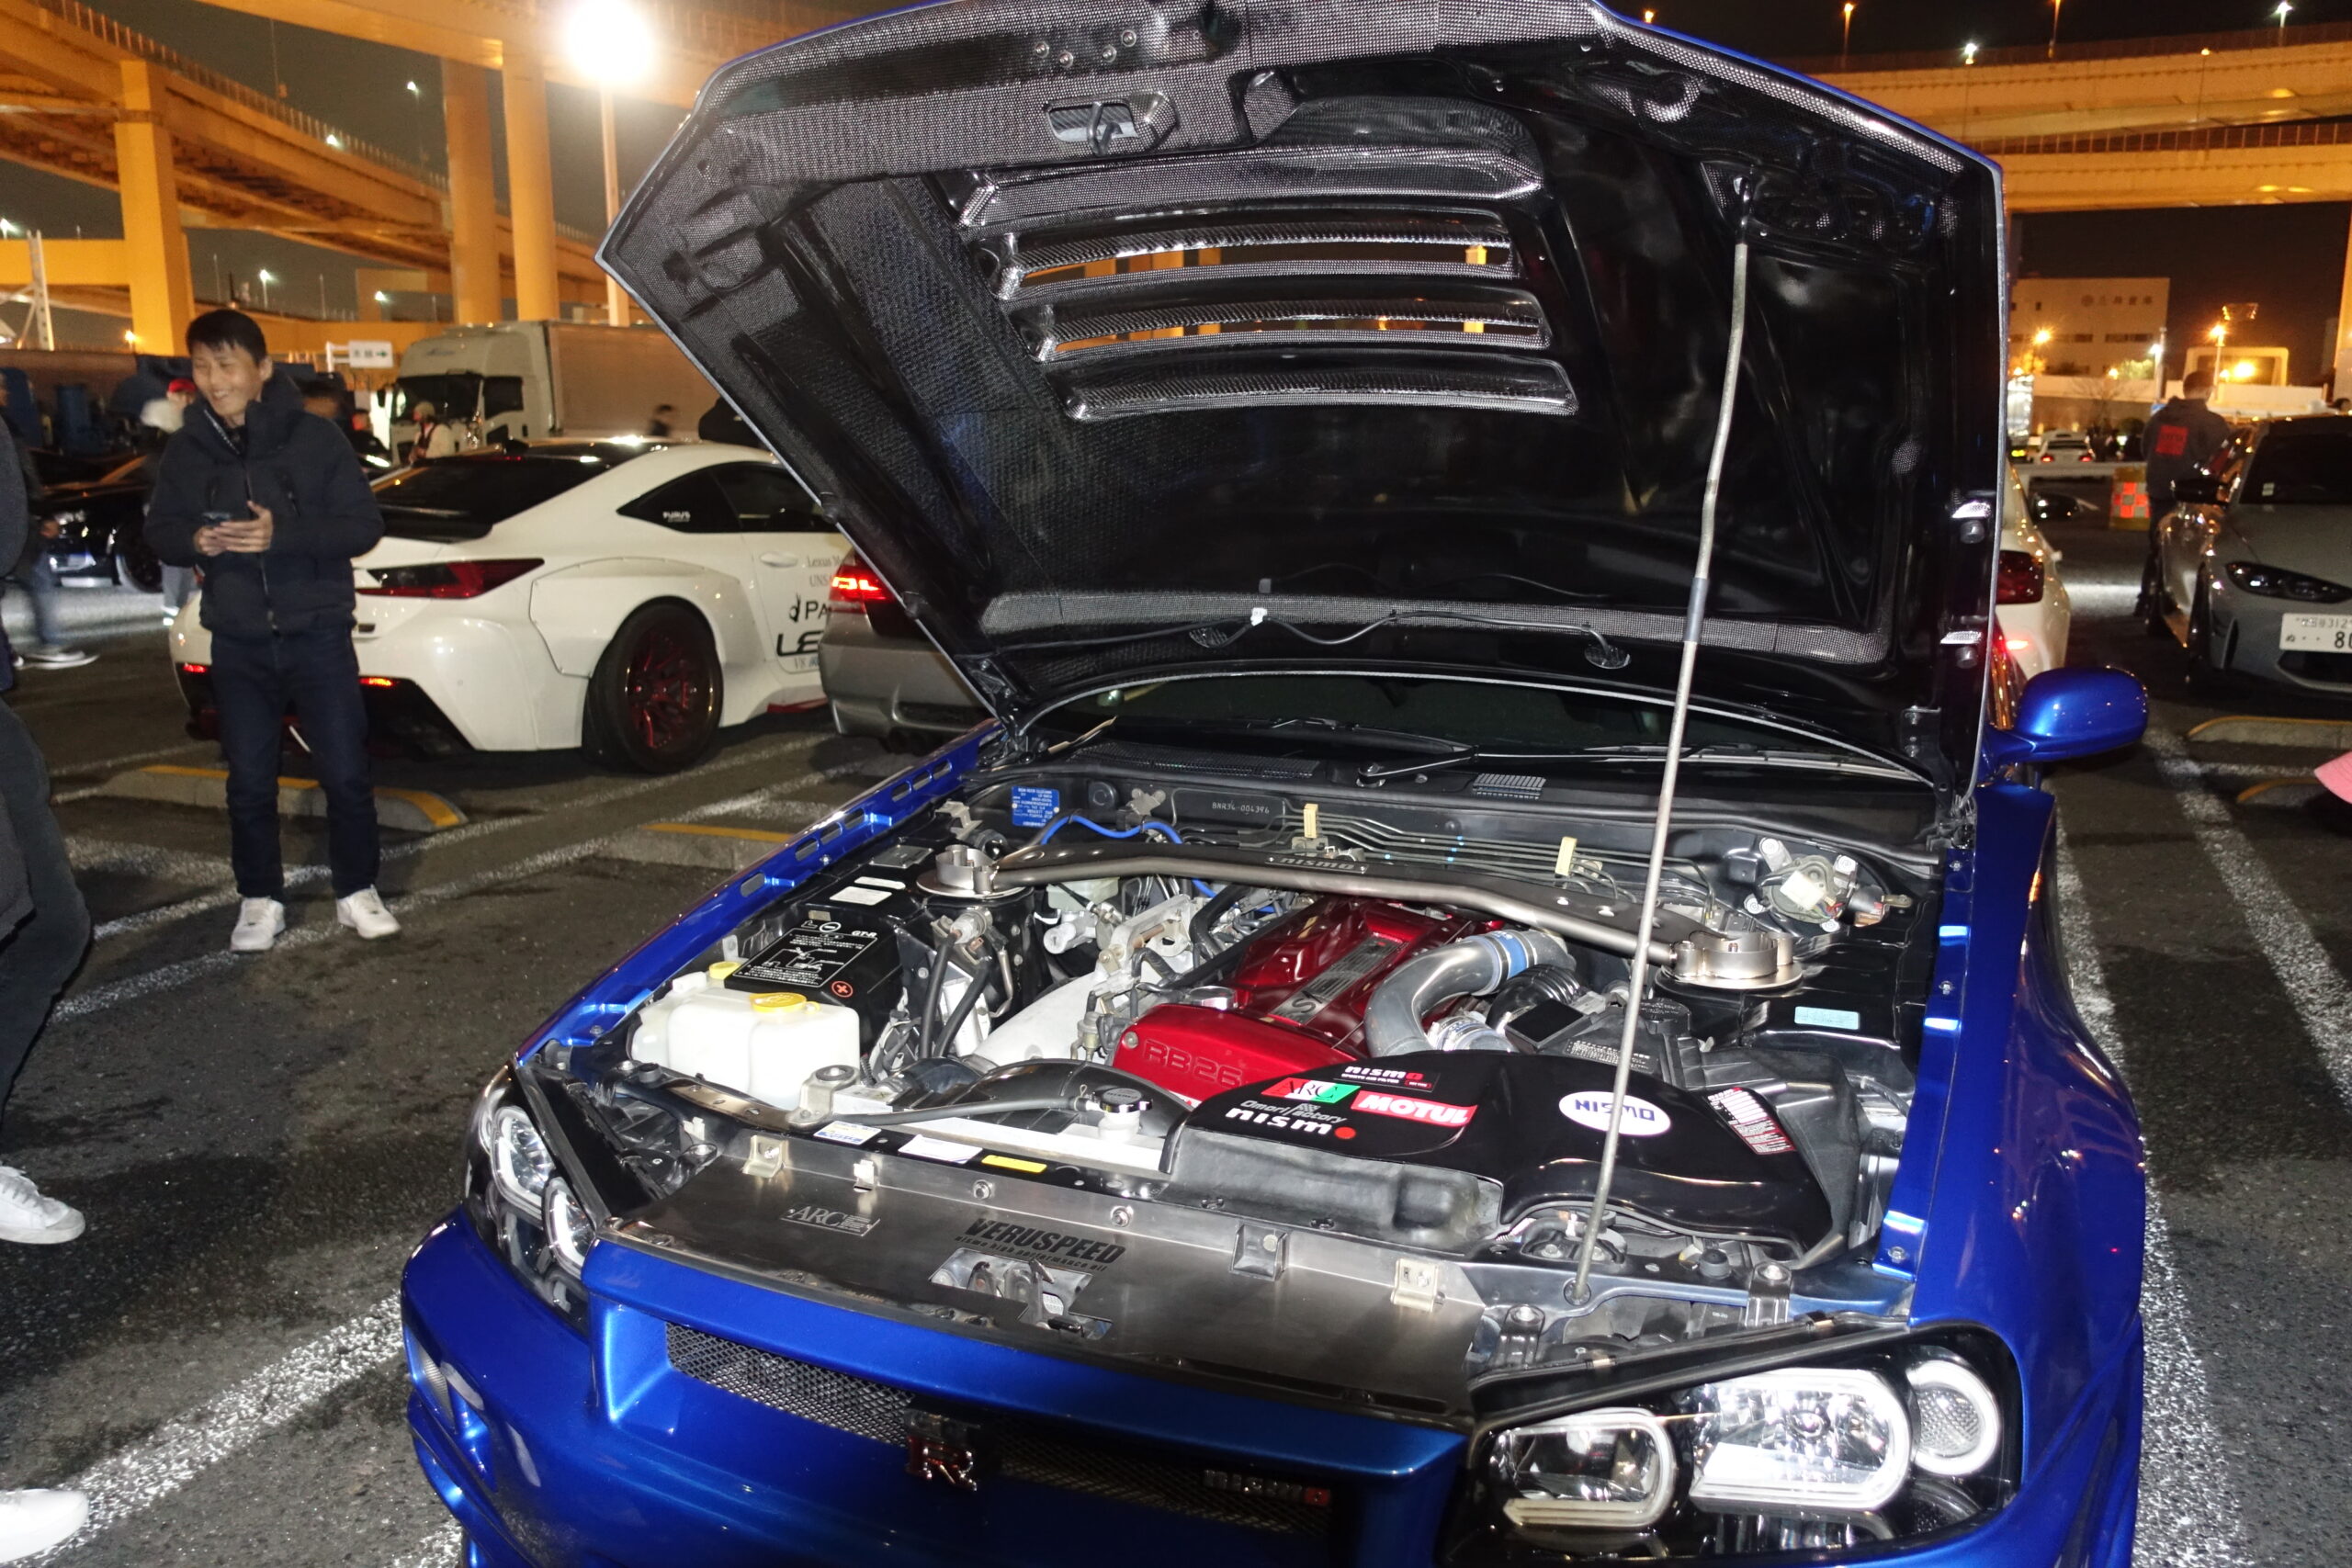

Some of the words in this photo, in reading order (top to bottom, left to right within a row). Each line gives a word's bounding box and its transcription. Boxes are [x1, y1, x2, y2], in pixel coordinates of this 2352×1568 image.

[1279, 857, 1355, 870] nismo
[852, 930, 877, 938] GT-R
[1345, 1066, 1424, 1080] nismo
[1271, 1080, 1339, 1098] ARC
[1358, 1095, 1468, 1124] MOTUL
[786, 1205, 848, 1227] ARC
[965, 1218, 1126, 1265] VERUSPEED
